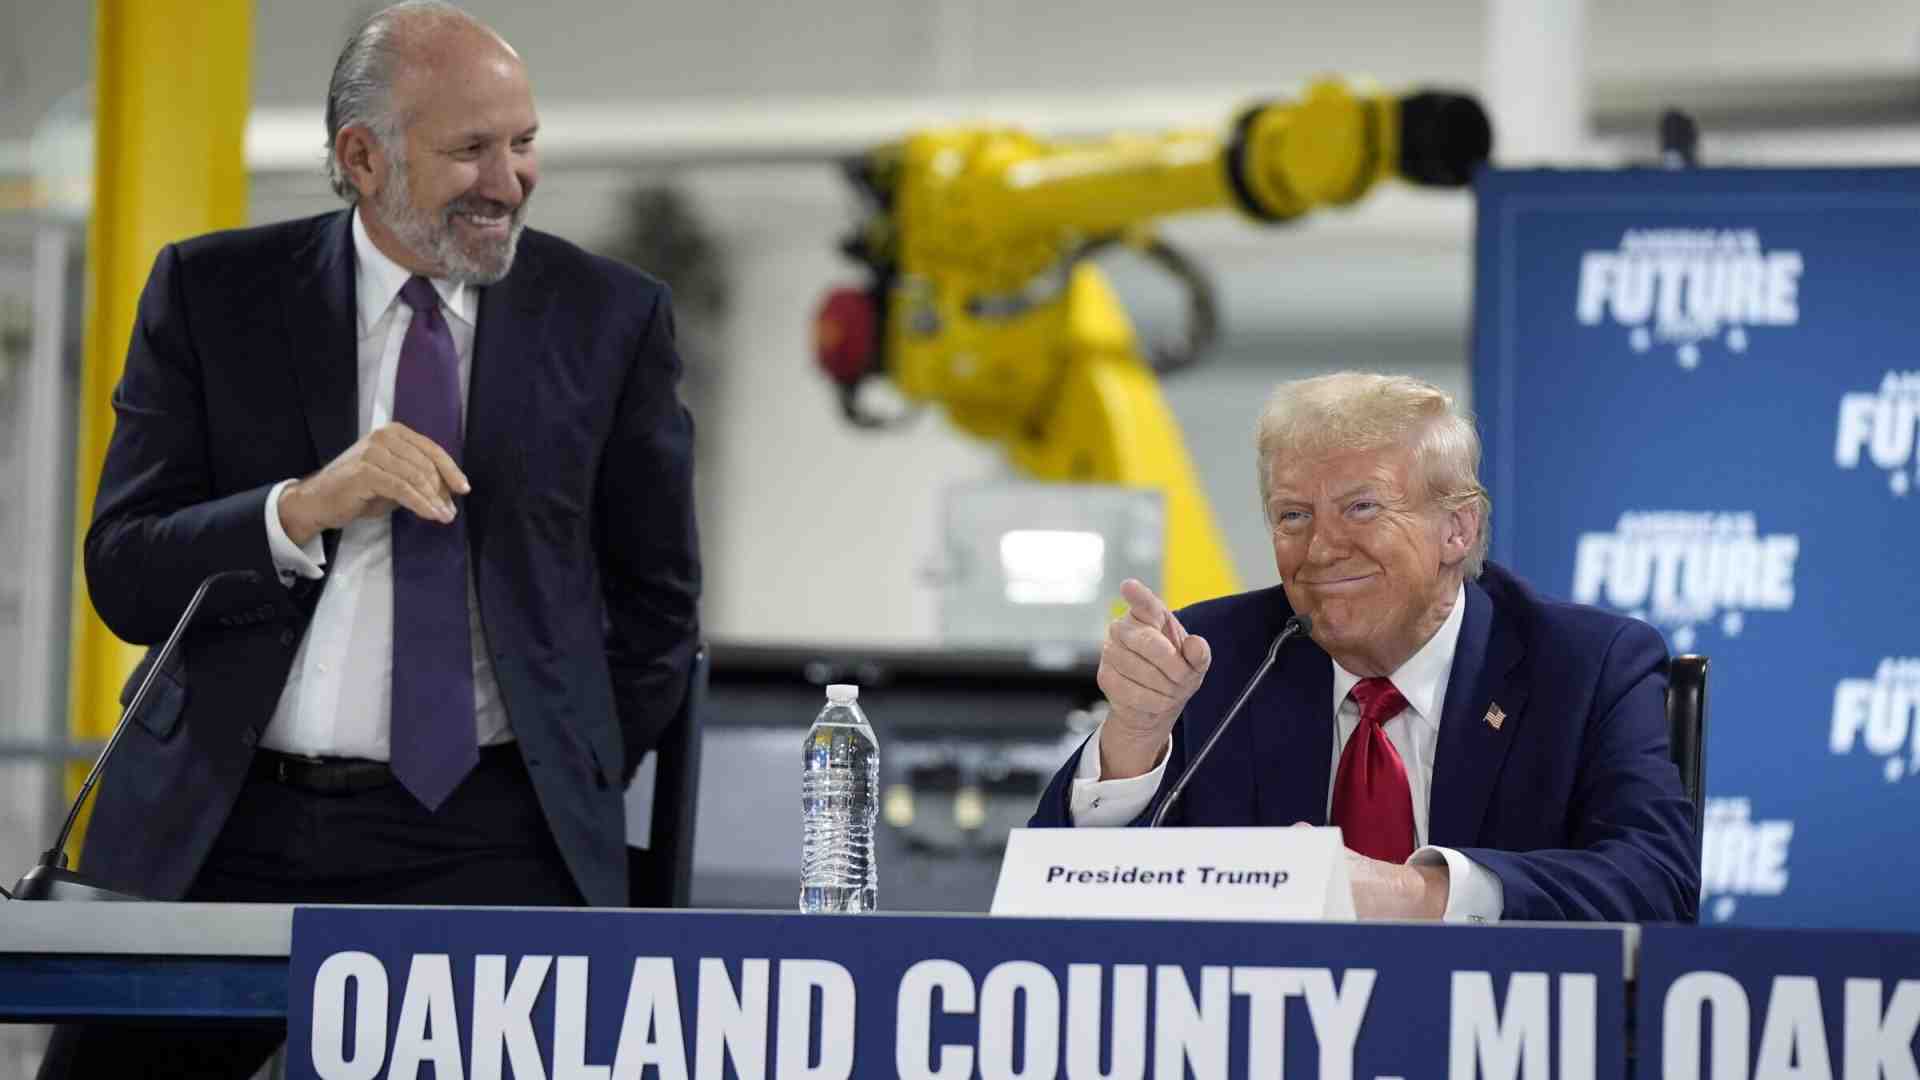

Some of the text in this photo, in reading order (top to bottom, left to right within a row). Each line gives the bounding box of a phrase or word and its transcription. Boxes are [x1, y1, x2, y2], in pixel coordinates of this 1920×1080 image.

[1577, 250, 1804, 325] FUTURE
[1573, 534, 1799, 611] FUTURE
[1046, 866, 1290, 888] President Trump
[311, 951, 1598, 1080] OAKLAND COUNTY MI
